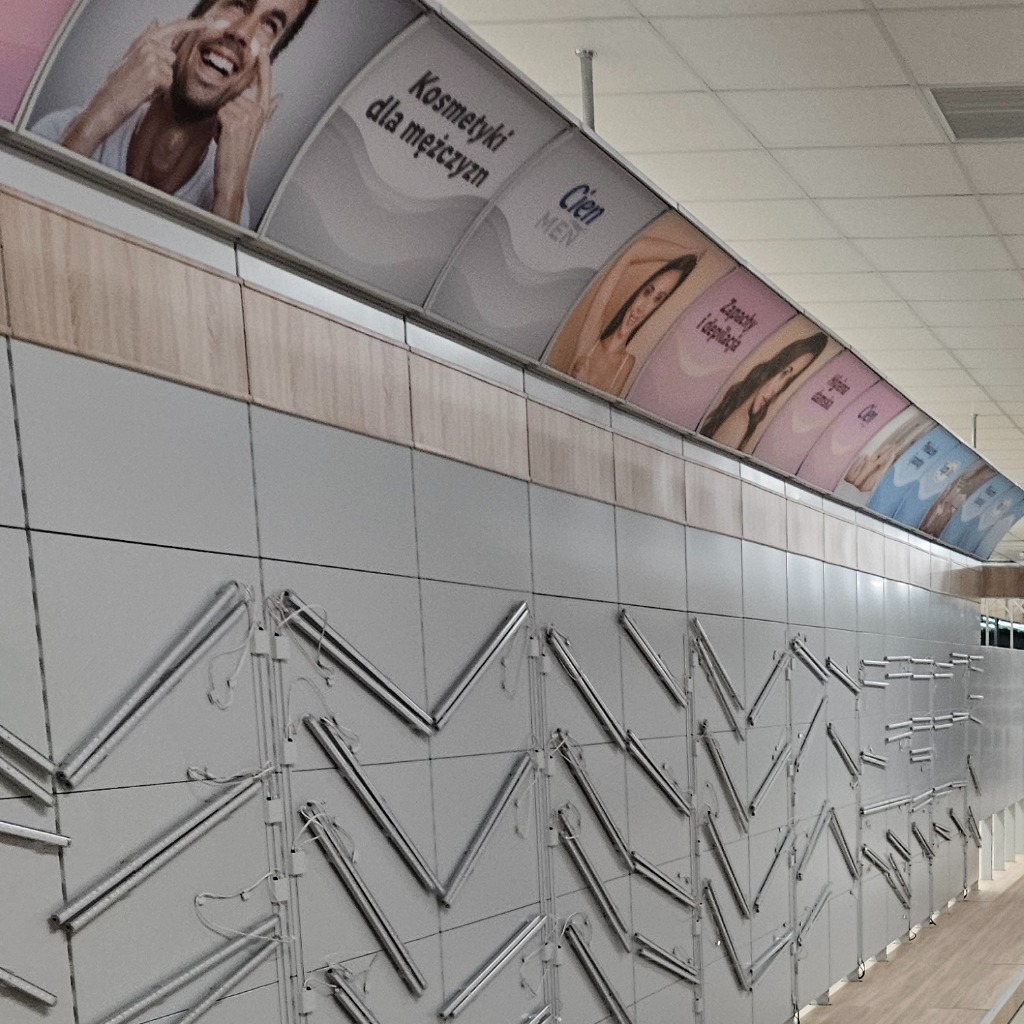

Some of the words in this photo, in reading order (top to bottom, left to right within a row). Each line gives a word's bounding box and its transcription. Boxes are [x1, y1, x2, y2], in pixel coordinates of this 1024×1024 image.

[365, 95, 404, 133] dla
[400, 118, 490, 188] mężczyzn
[408, 70, 515, 153] Kosmetyki
[559, 183, 606, 226] Cien
